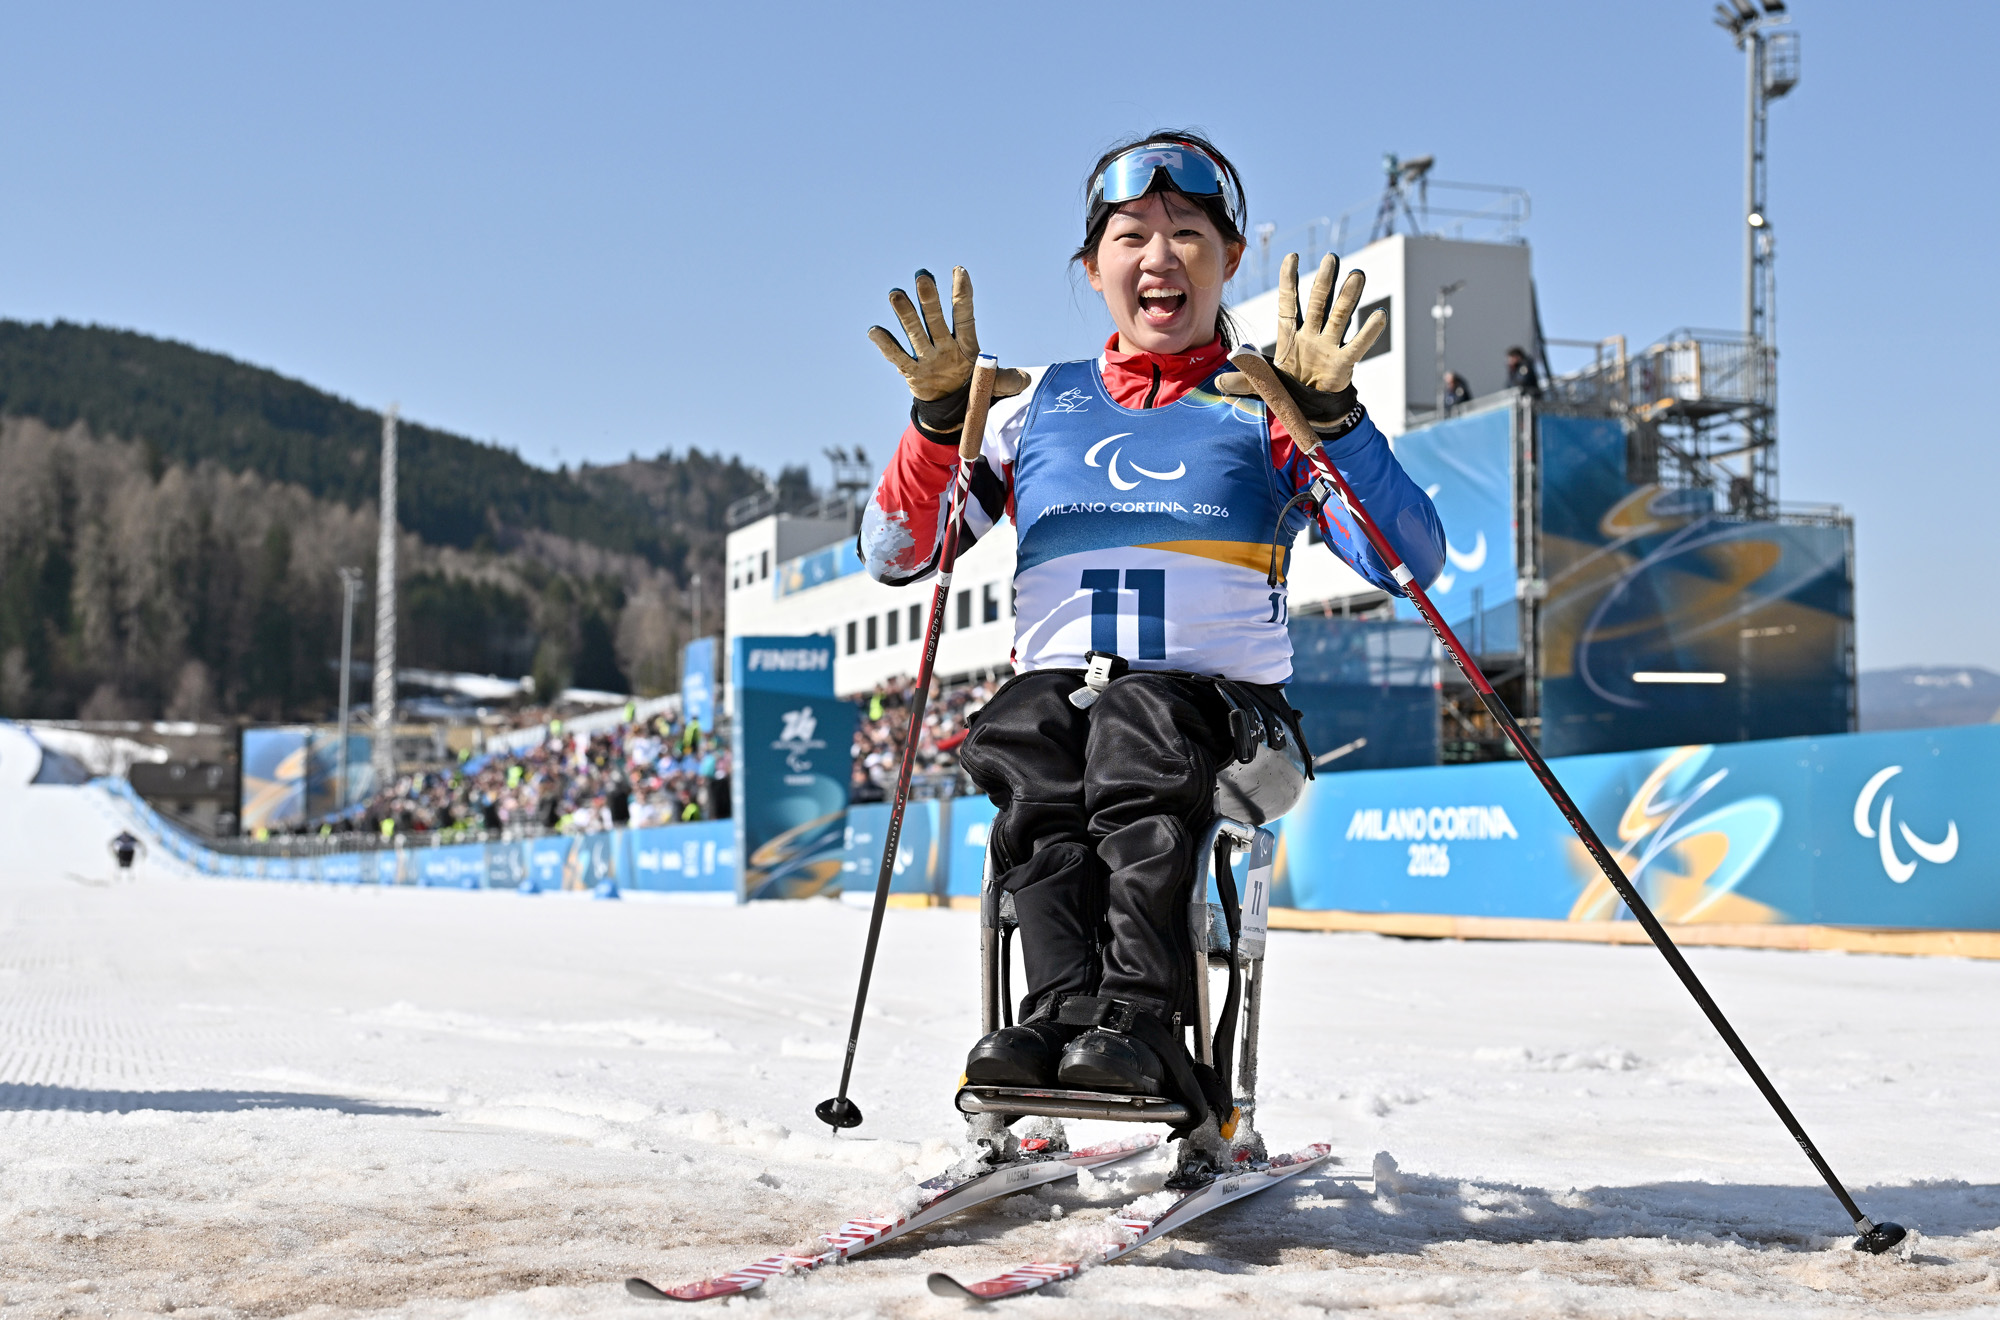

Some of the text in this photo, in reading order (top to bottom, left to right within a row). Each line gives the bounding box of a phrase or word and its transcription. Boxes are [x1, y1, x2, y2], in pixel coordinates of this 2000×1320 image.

[1038, 502, 1229, 519] MILANO CORTINA 2026
[934, 586, 945, 617] TRIAC
[1080, 569, 1166, 660] 11
[1402, 584, 1429, 618] TRIAC
[1438, 637, 1464, 667] AERO
[748, 649, 829, 671] FINISH
[926, 633, 936, 662] AERO
[1345, 805, 1519, 841] MILANO CORTINA
[886, 816, 900, 869] TECHNOLOGY
[1406, 842, 1451, 877] 2026
[1584, 841, 1631, 905] TECHNOLOGY
[1251, 881, 1263, 916] 11
